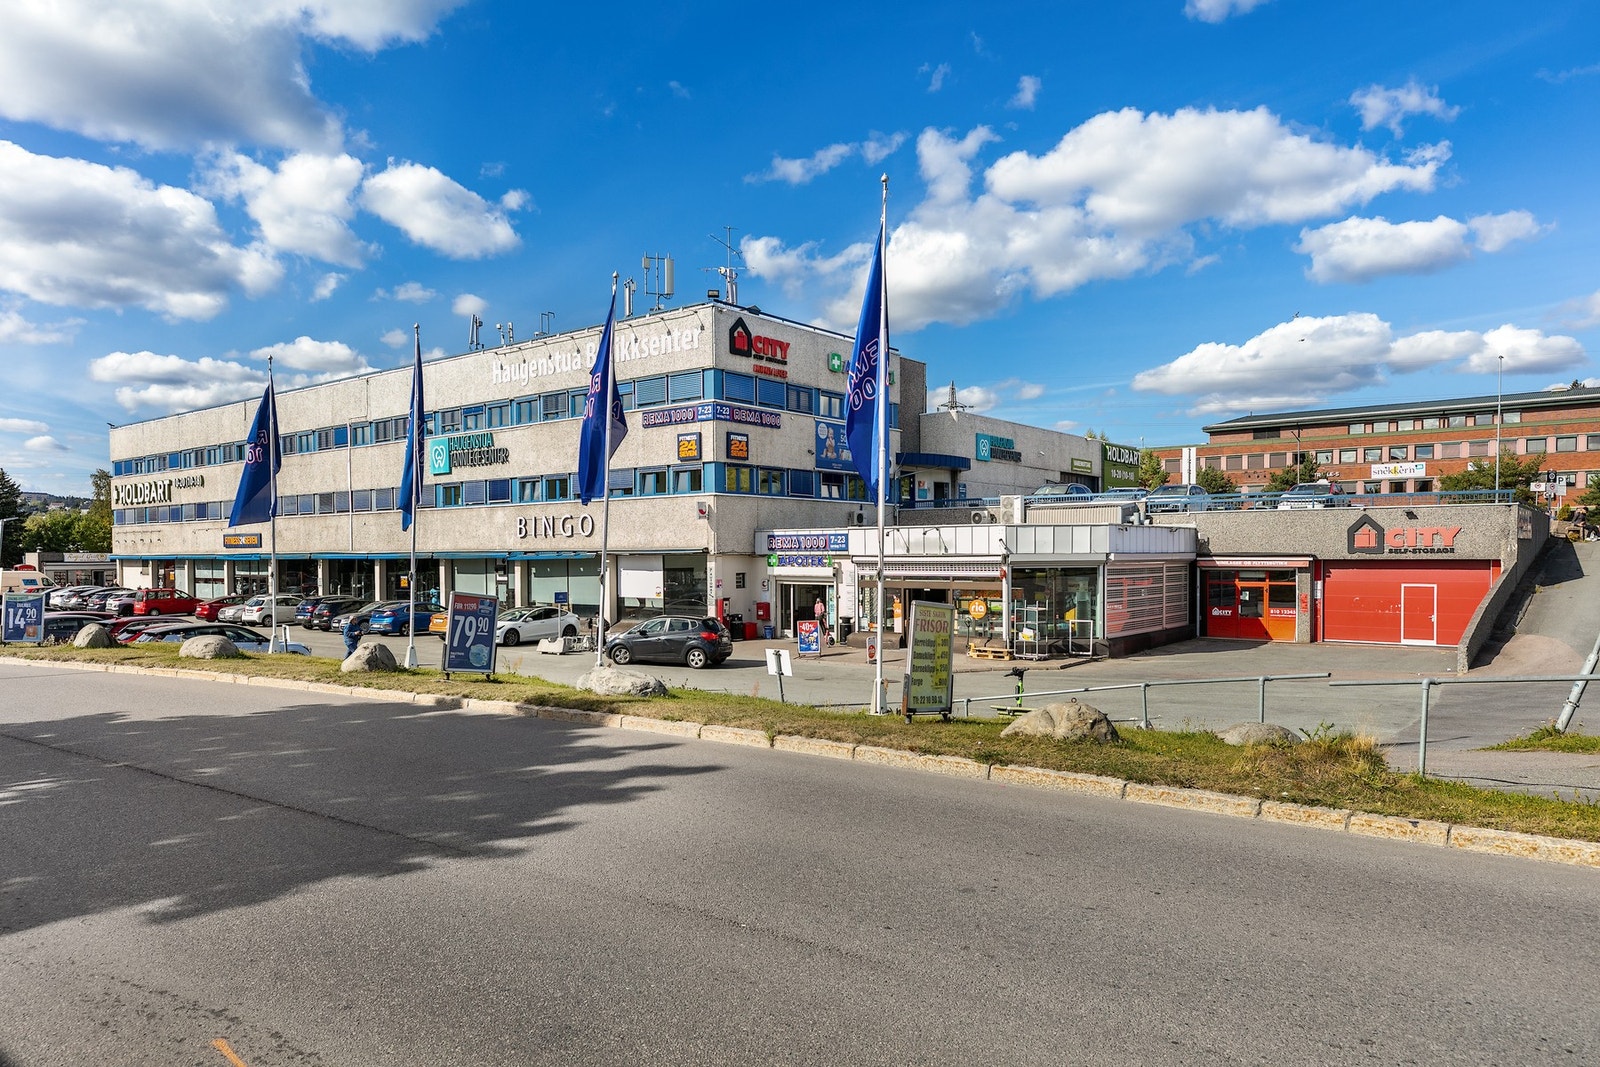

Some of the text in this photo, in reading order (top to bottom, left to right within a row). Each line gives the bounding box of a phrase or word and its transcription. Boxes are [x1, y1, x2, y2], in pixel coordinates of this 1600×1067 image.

[492, 352, 582, 386] Haugenstua
[586, 326, 702, 368] Bikksenter
[752, 335, 790, 360] CITY
[643, 406, 712, 425] REMA 1000 7-23
[716, 406, 781, 427] 7-23 REMA 1000
[679, 440, 697, 451] 24
[730, 440, 747, 451] 24
[1107, 446, 1141, 466] HOLDBART
[119, 479, 173, 505] HOLDBART
[517, 513, 594, 538] BINGO
[768, 536, 800, 549] REMA
[801, 536, 826, 549] 1000
[830, 535, 846, 544] 7-23
[1385, 526, 1462, 547] CITY
[779, 555, 826, 566] APOTEK
[971, 602, 985, 612] ria
[8, 608, 37, 629] 14 90
[799, 622, 815, 631] -40%
[915, 618, 949, 634] FRISØR
[452, 615, 489, 648] 79 90
